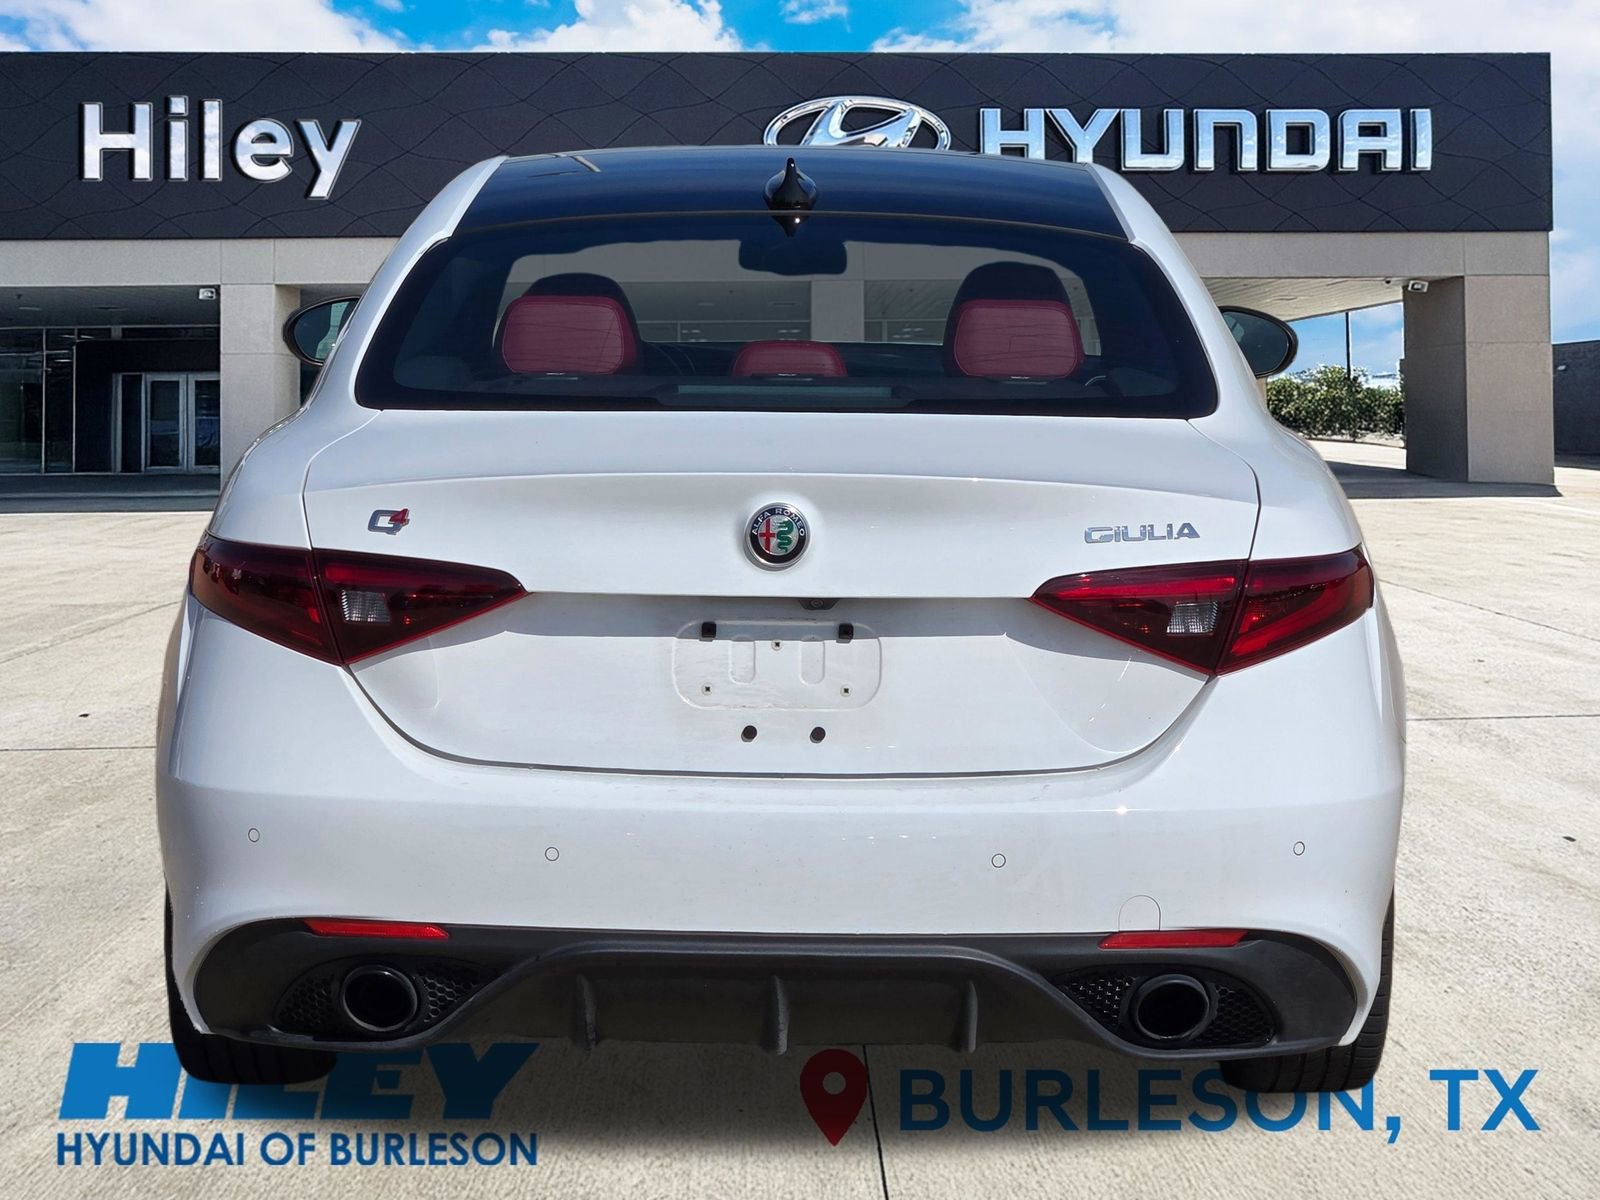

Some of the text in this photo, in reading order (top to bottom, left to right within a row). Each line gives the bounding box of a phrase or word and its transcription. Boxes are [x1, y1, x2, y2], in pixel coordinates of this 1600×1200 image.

[81, 95, 362, 199] Hiley
[980, 108, 1432, 172] HYUNDAI
[368, 508, 410, 535] Q4
[751, 508, 805, 536] ALFA ROMEO
[1084, 522, 1200, 544] GIULIA
